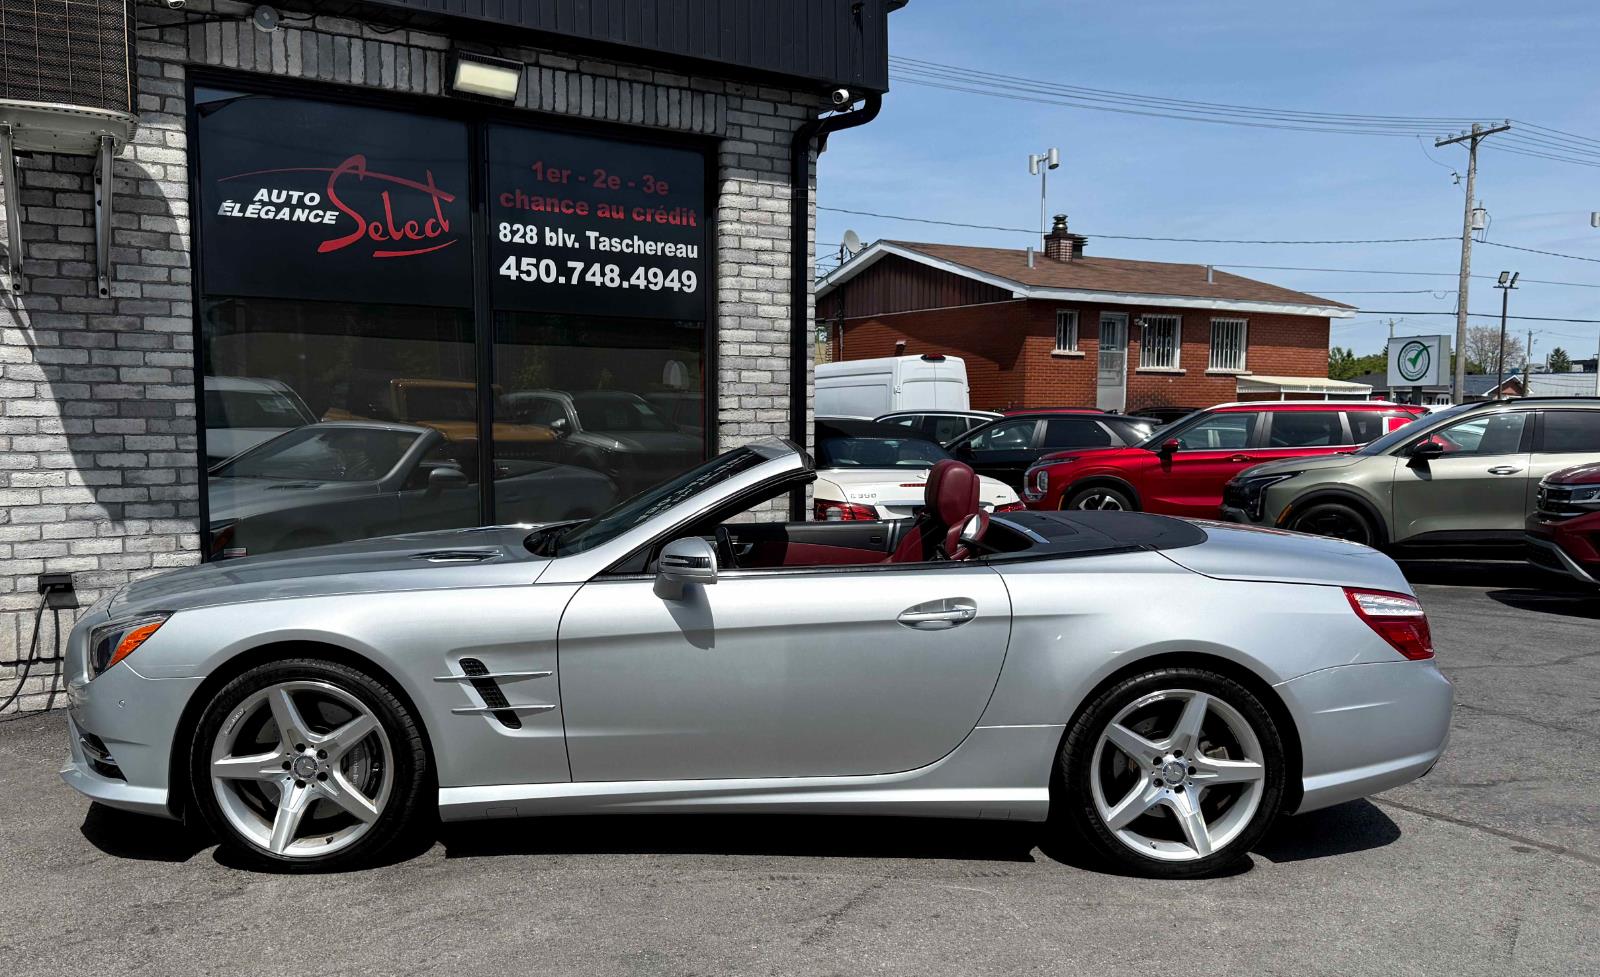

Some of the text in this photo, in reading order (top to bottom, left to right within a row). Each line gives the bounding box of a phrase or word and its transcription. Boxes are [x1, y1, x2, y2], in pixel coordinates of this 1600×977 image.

[531, 160, 571, 184] 1er
[592, 168, 621, 190] 2e
[642, 174, 669, 196] 3e
[217, 200, 340, 225] ÉLÉGANCE
[253, 188, 321, 206] AUTO
[317, 154, 455, 253] Select
[499, 189, 697, 227] chance au crédit
[498, 222, 699, 259] 828 blv. Taschereau
[499, 255, 698, 294] 450.748.4949
